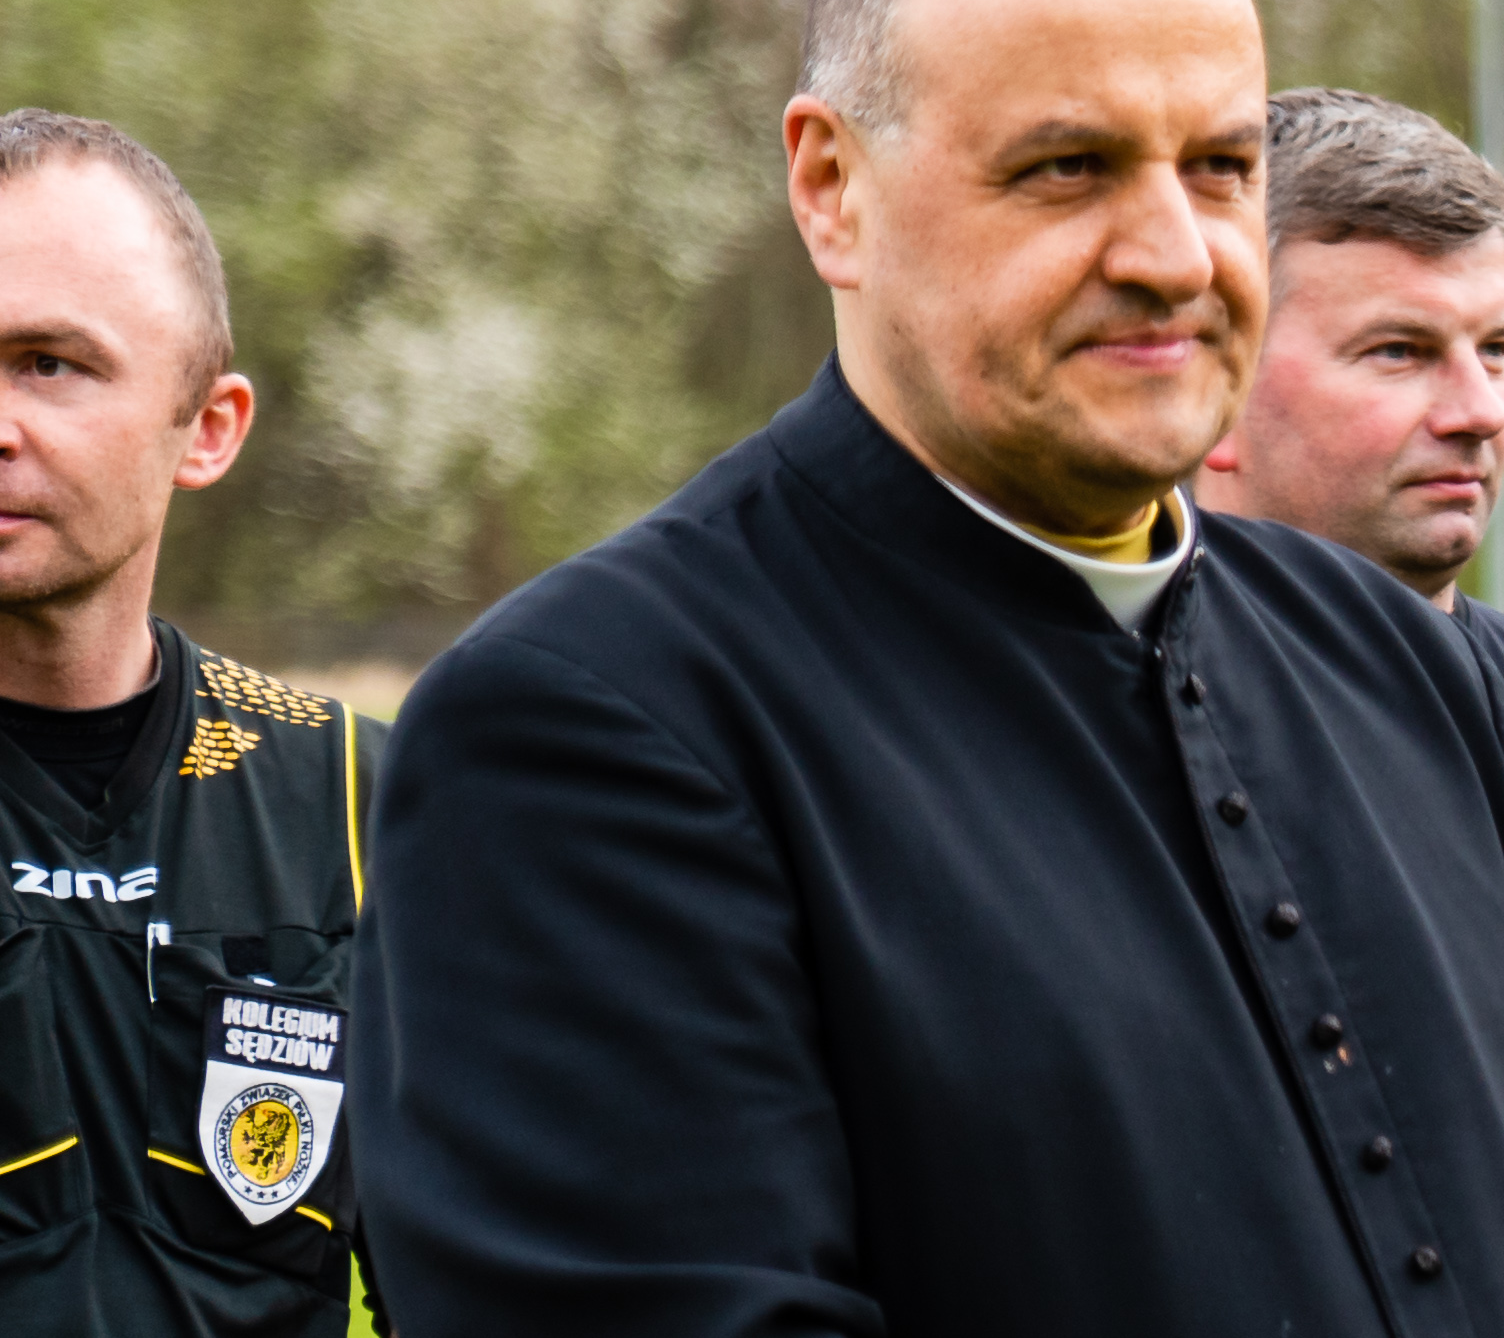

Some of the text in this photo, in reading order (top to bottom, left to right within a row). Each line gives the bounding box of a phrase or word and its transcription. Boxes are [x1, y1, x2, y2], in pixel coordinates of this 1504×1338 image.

[222, 997, 340, 1042] KOLEGIUM
[225, 1027, 335, 1071] SĘDZIÓW
[217, 1105, 239, 1179] POMORSKI
